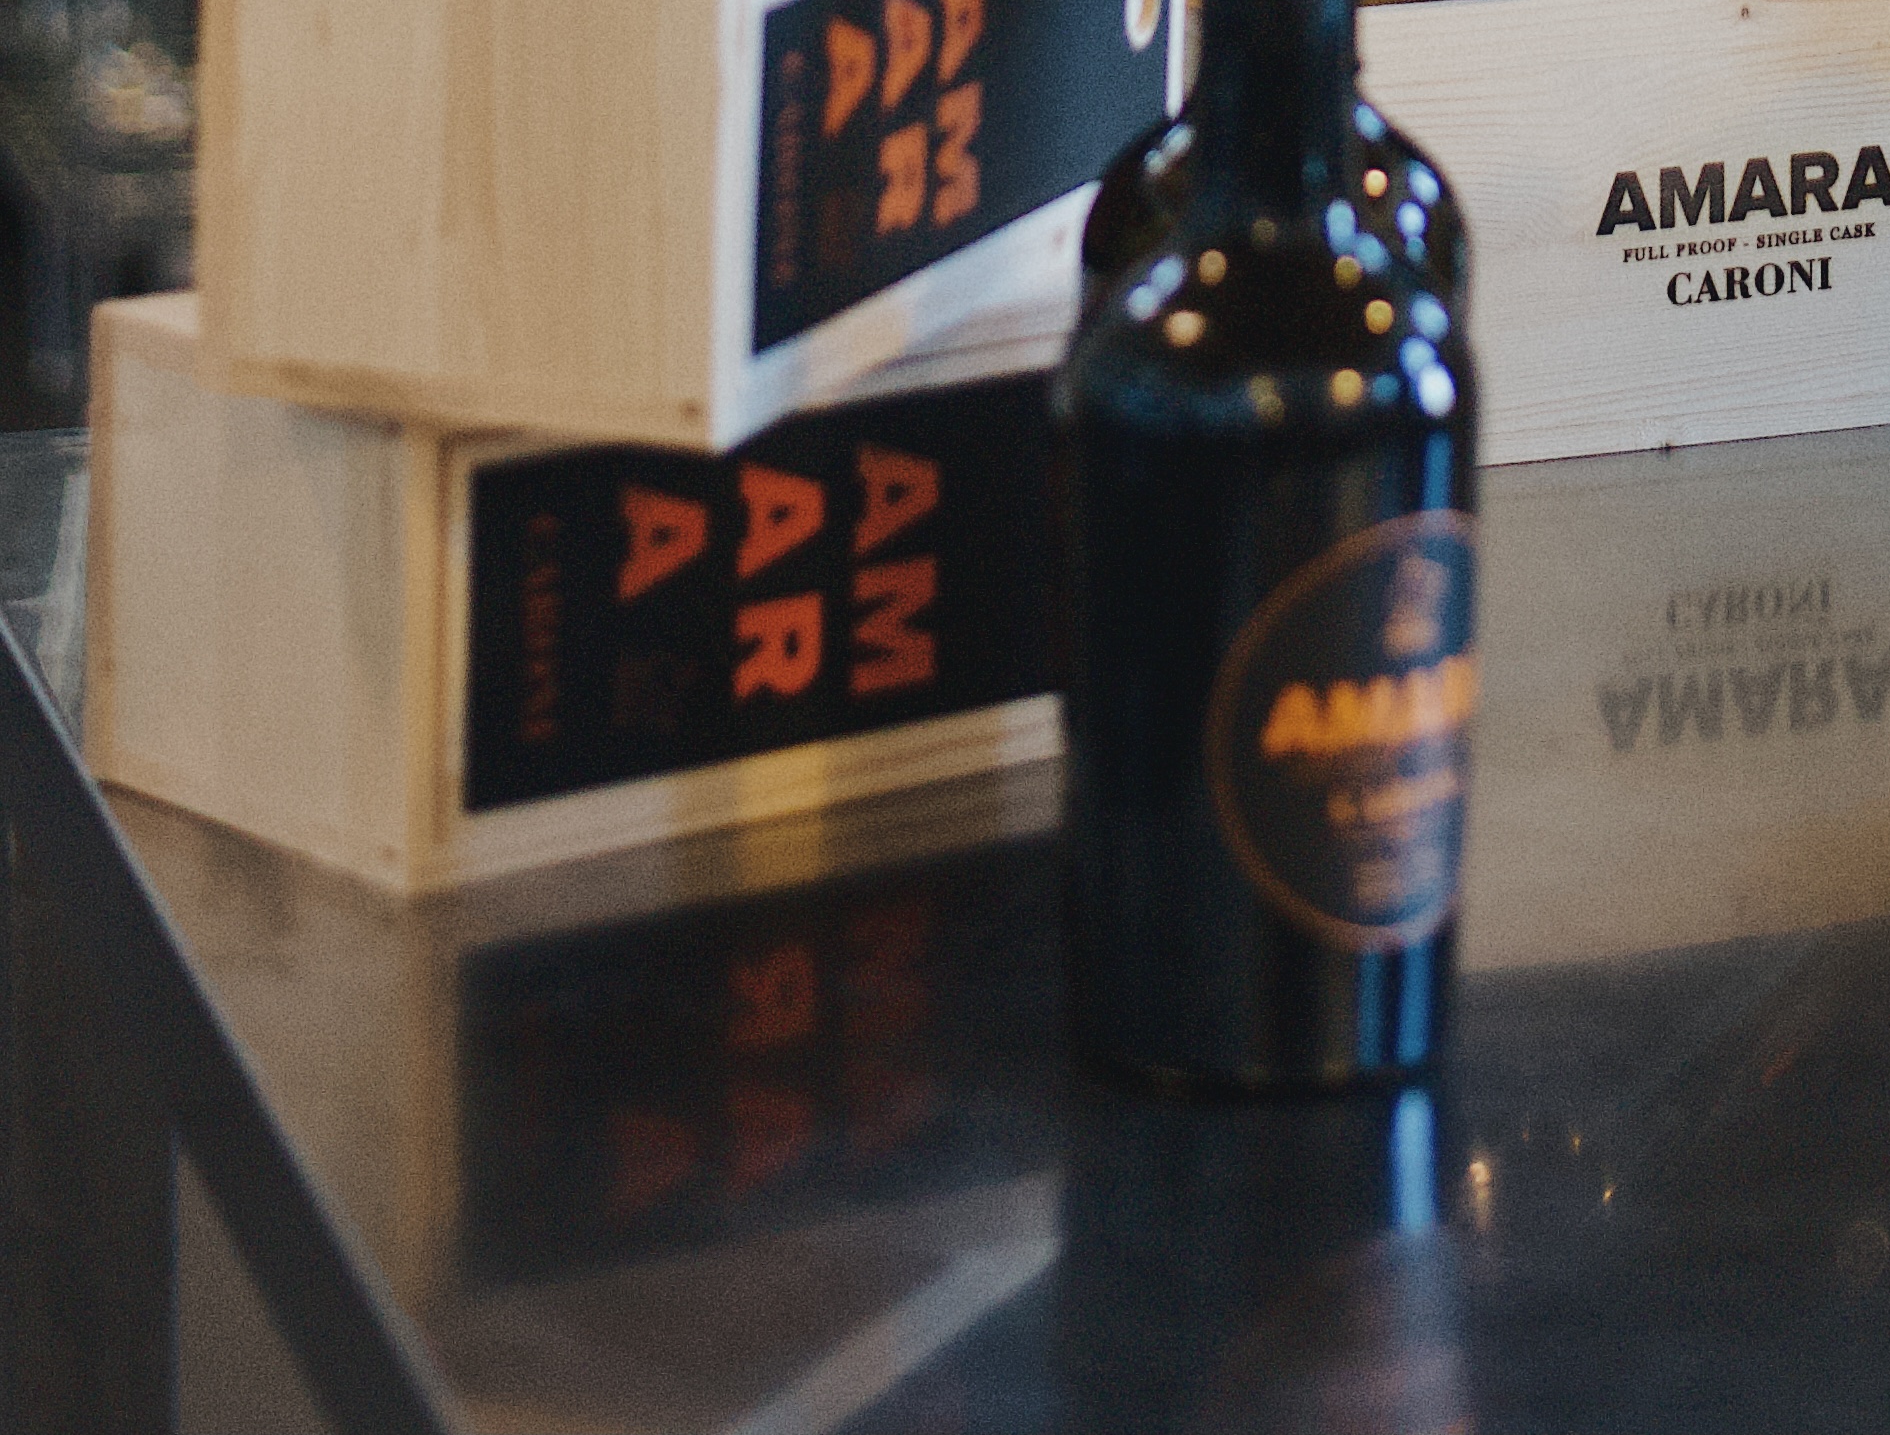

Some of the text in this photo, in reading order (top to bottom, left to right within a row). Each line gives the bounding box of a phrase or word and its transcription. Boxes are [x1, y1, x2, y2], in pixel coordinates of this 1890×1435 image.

[1622, 246, 1670, 263] FULL
[1676, 237, 1738, 258] PROOF
[1756, 228, 1824, 249] SINGLE
[1830, 222, 1877, 241] CASK
[1666, 256, 1833, 306] CARONI
[616, 482, 710, 605] A
[731, 461, 828, 701] AR
[847, 441, 941, 696] AM
